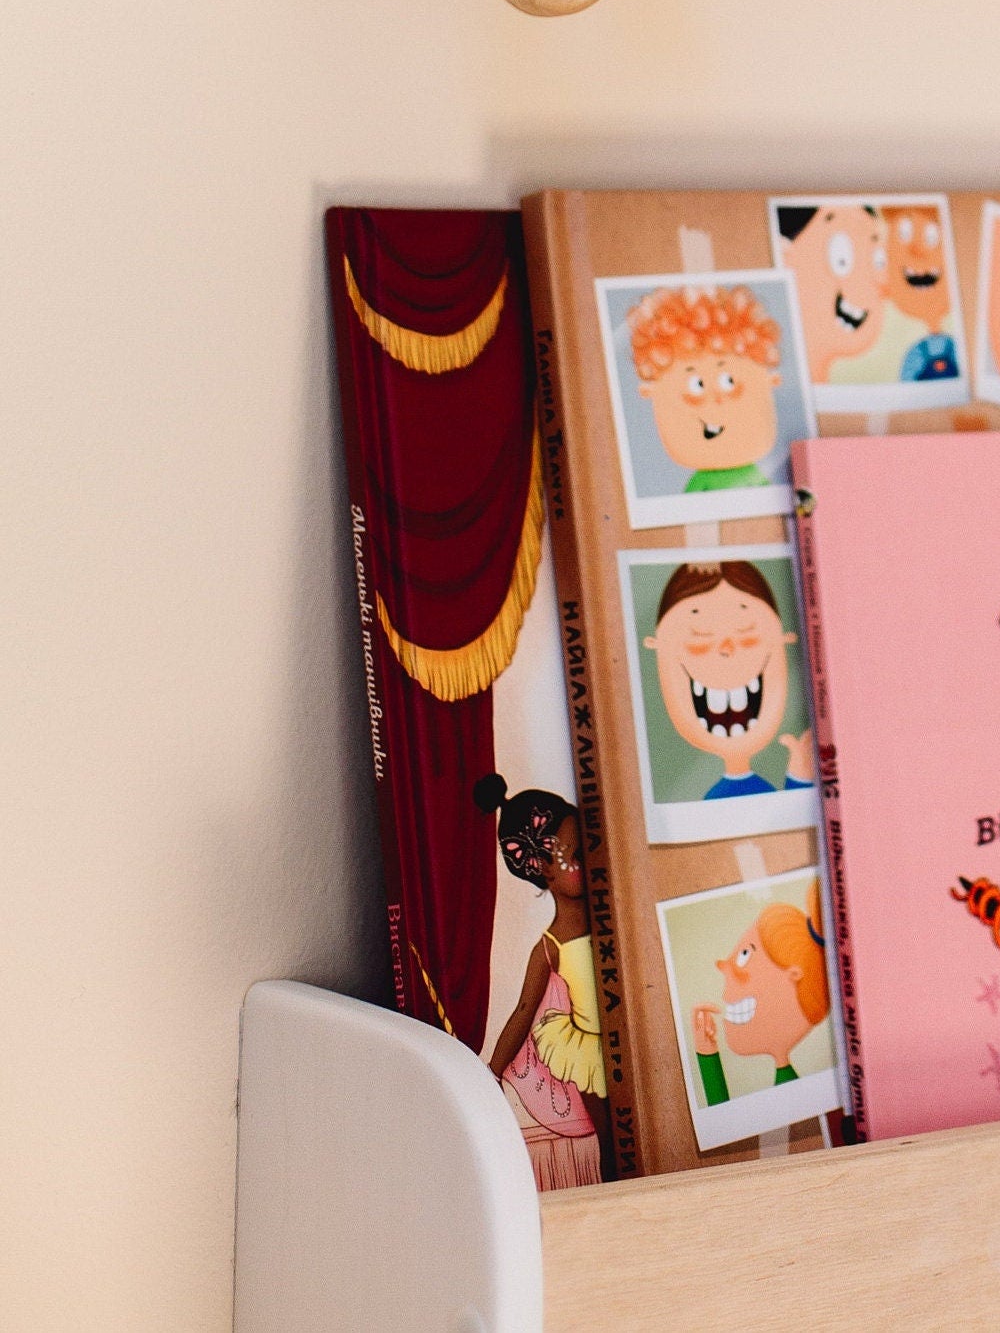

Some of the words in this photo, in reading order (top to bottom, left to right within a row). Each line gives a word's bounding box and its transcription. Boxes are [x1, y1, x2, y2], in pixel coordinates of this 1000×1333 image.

[350, 503, 373, 626] Маленькі
[362, 629, 386, 782] танцівники
[563, 601, 602, 852] НАЙВАЖЛИВІША
[590, 868, 622, 1013] КНИЖКА
[615, 1106, 637, 1174] ЗУБИ
